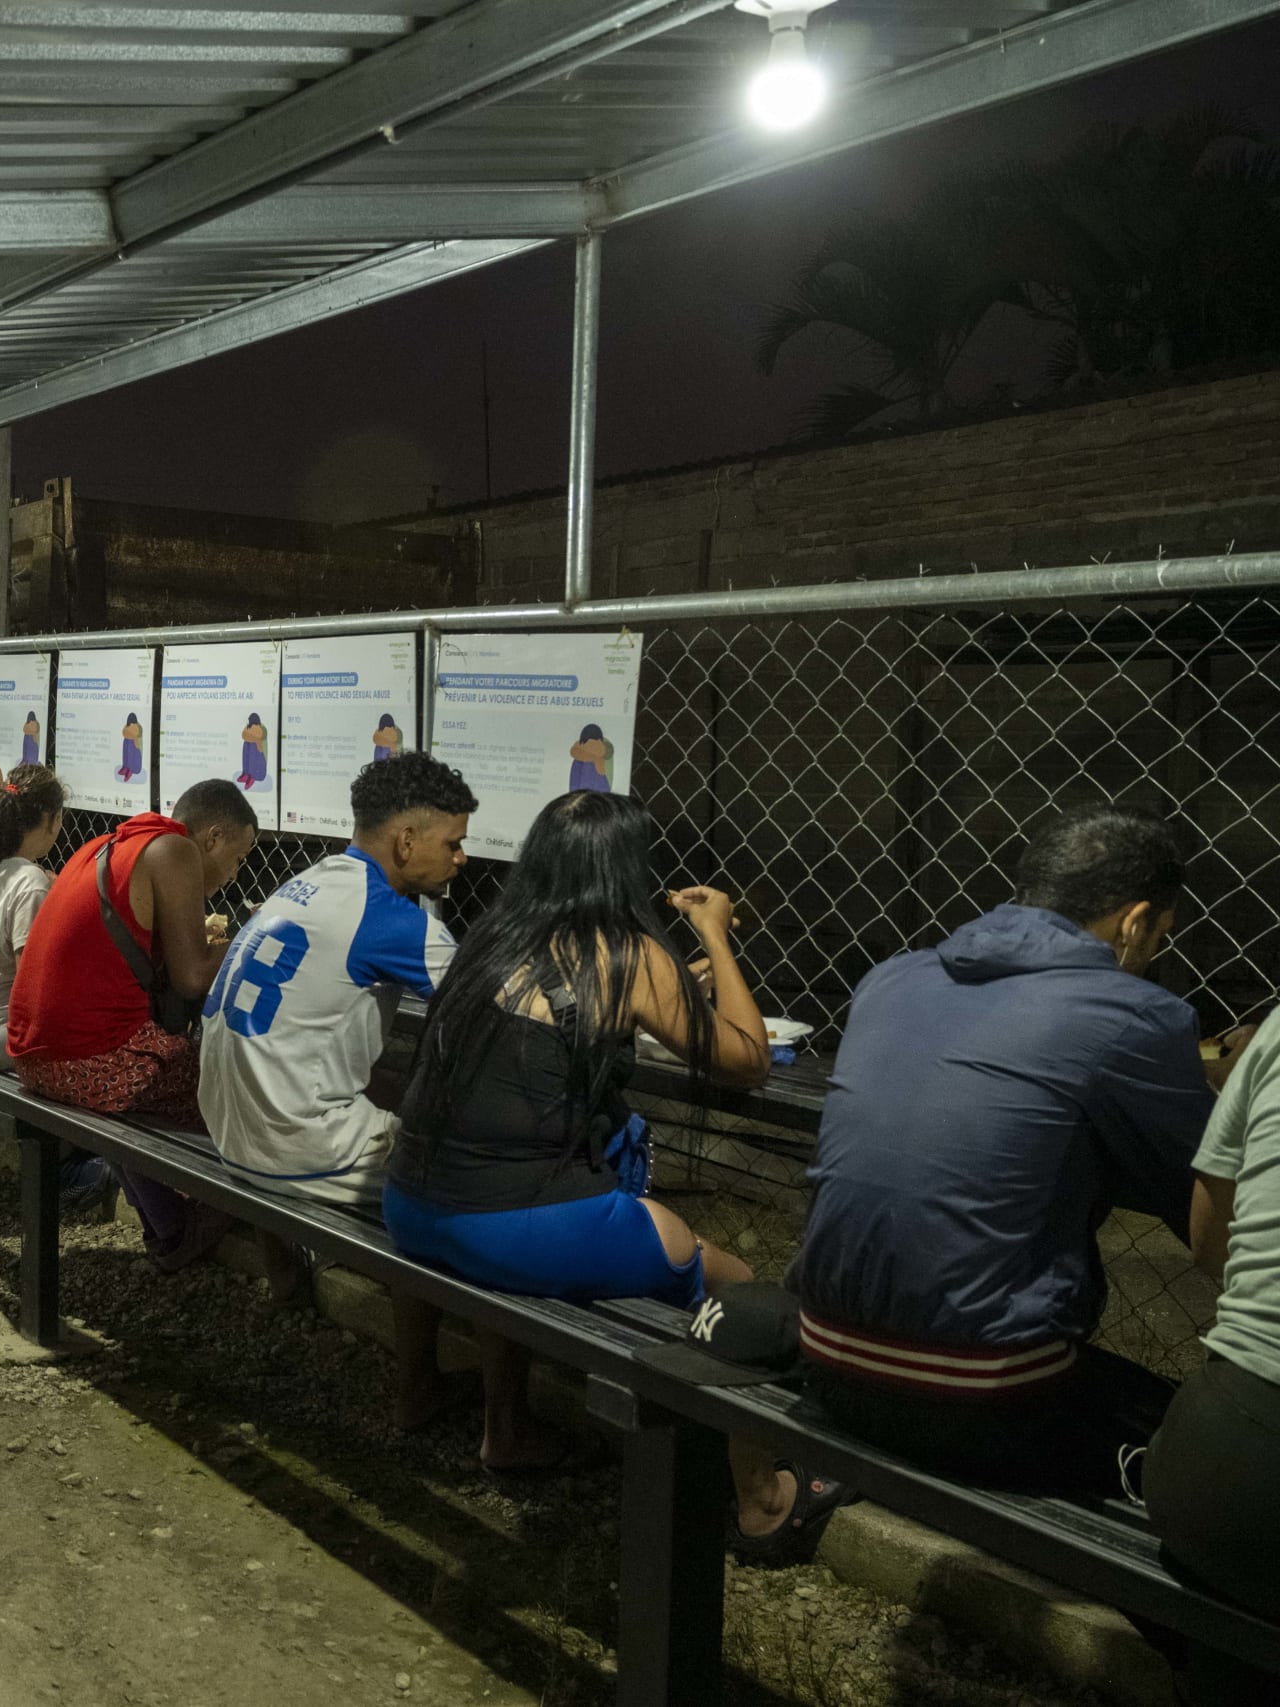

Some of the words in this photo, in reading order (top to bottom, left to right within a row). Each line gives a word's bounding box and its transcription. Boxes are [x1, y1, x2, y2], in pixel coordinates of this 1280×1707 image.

[445, 676, 474, 686] PENDANT
[475, 677, 495, 687] VOTRE
[495, 678, 530, 688] PARCOURS
[531, 679, 572, 689] MIGRATOIRE
[315, 691, 339, 699] VIOLENCE
[478, 695, 487, 703] LA
[489, 695, 526, 705] VIOLENCE
[527, 696, 535, 705] ET
[536, 696, 548, 706] LES
[549, 696, 570, 707] ABUS
[572, 697, 605, 707] SEXUELS
